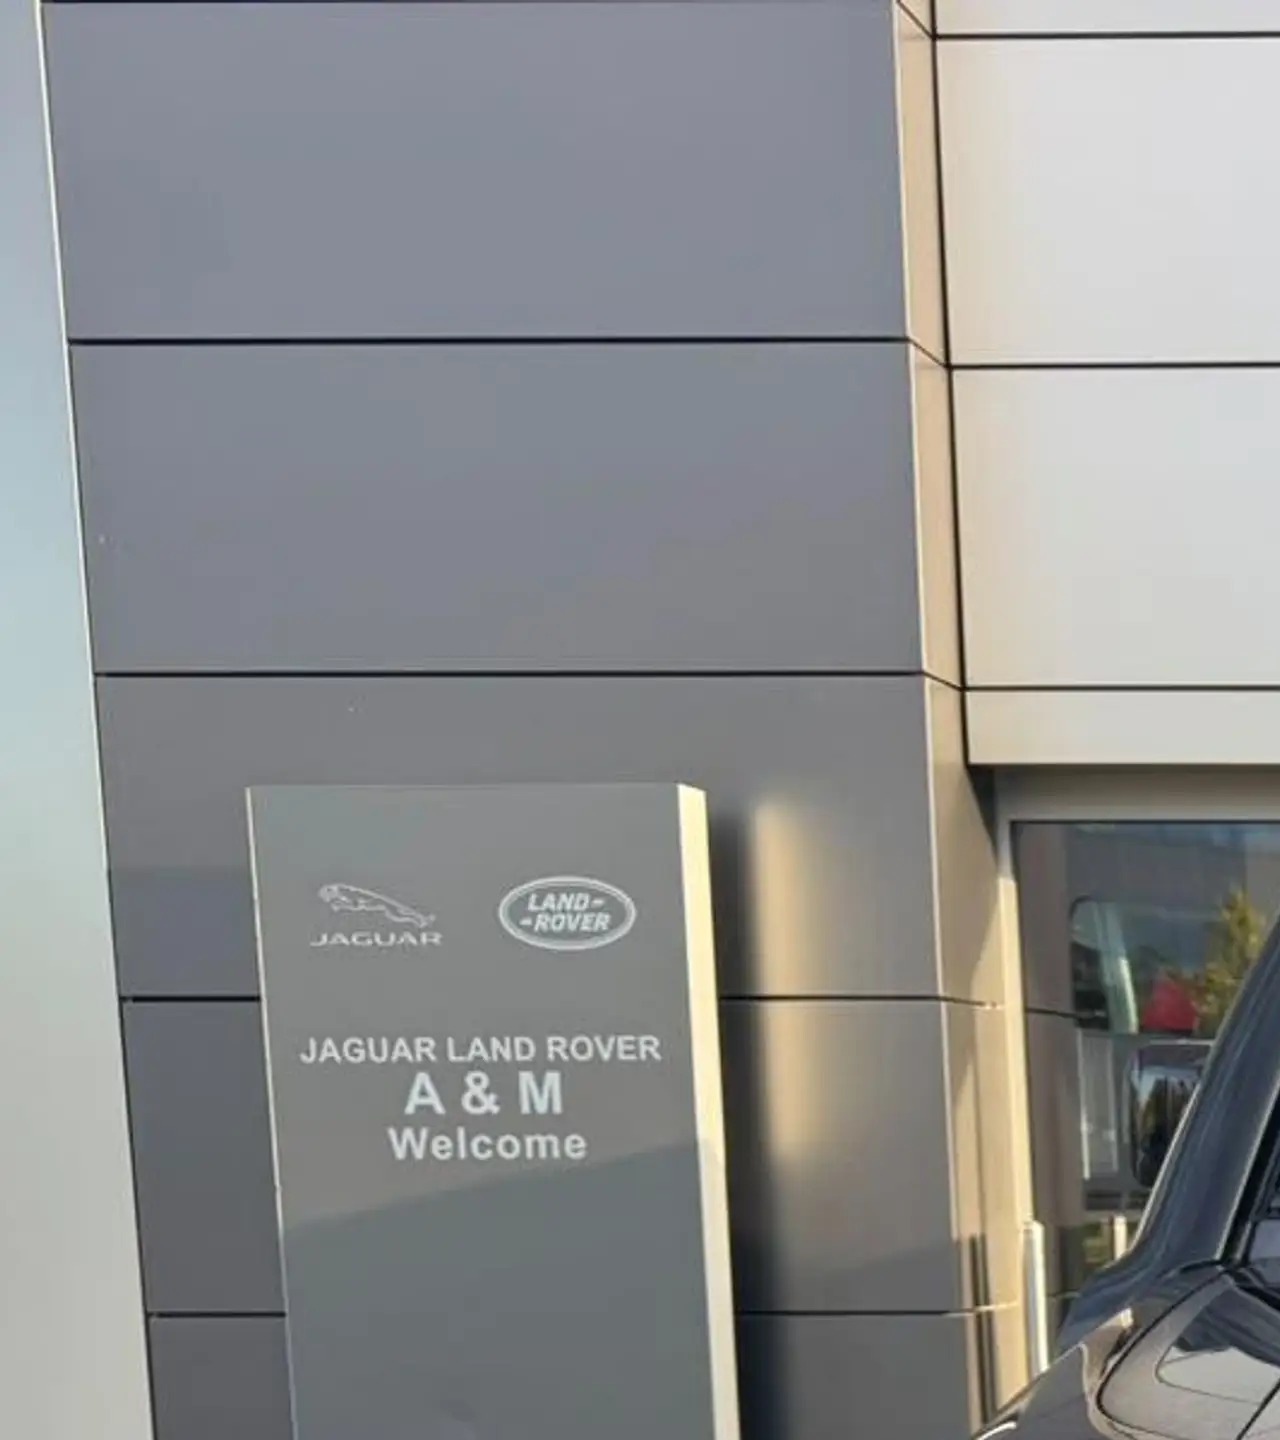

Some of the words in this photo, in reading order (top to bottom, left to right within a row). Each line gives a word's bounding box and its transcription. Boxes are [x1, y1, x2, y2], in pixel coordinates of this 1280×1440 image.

[309, 931, 443, 947] JAGUAR
[300, 1036, 437, 1064] JAGUAR
[447, 1036, 536, 1062] LAND
[547, 1035, 662, 1061] ROVER
[404, 1071, 446, 1115] A
[460, 1070, 501, 1115] &
[518, 1070, 563, 1115] M
[387, 1126, 588, 1160] Welcome
